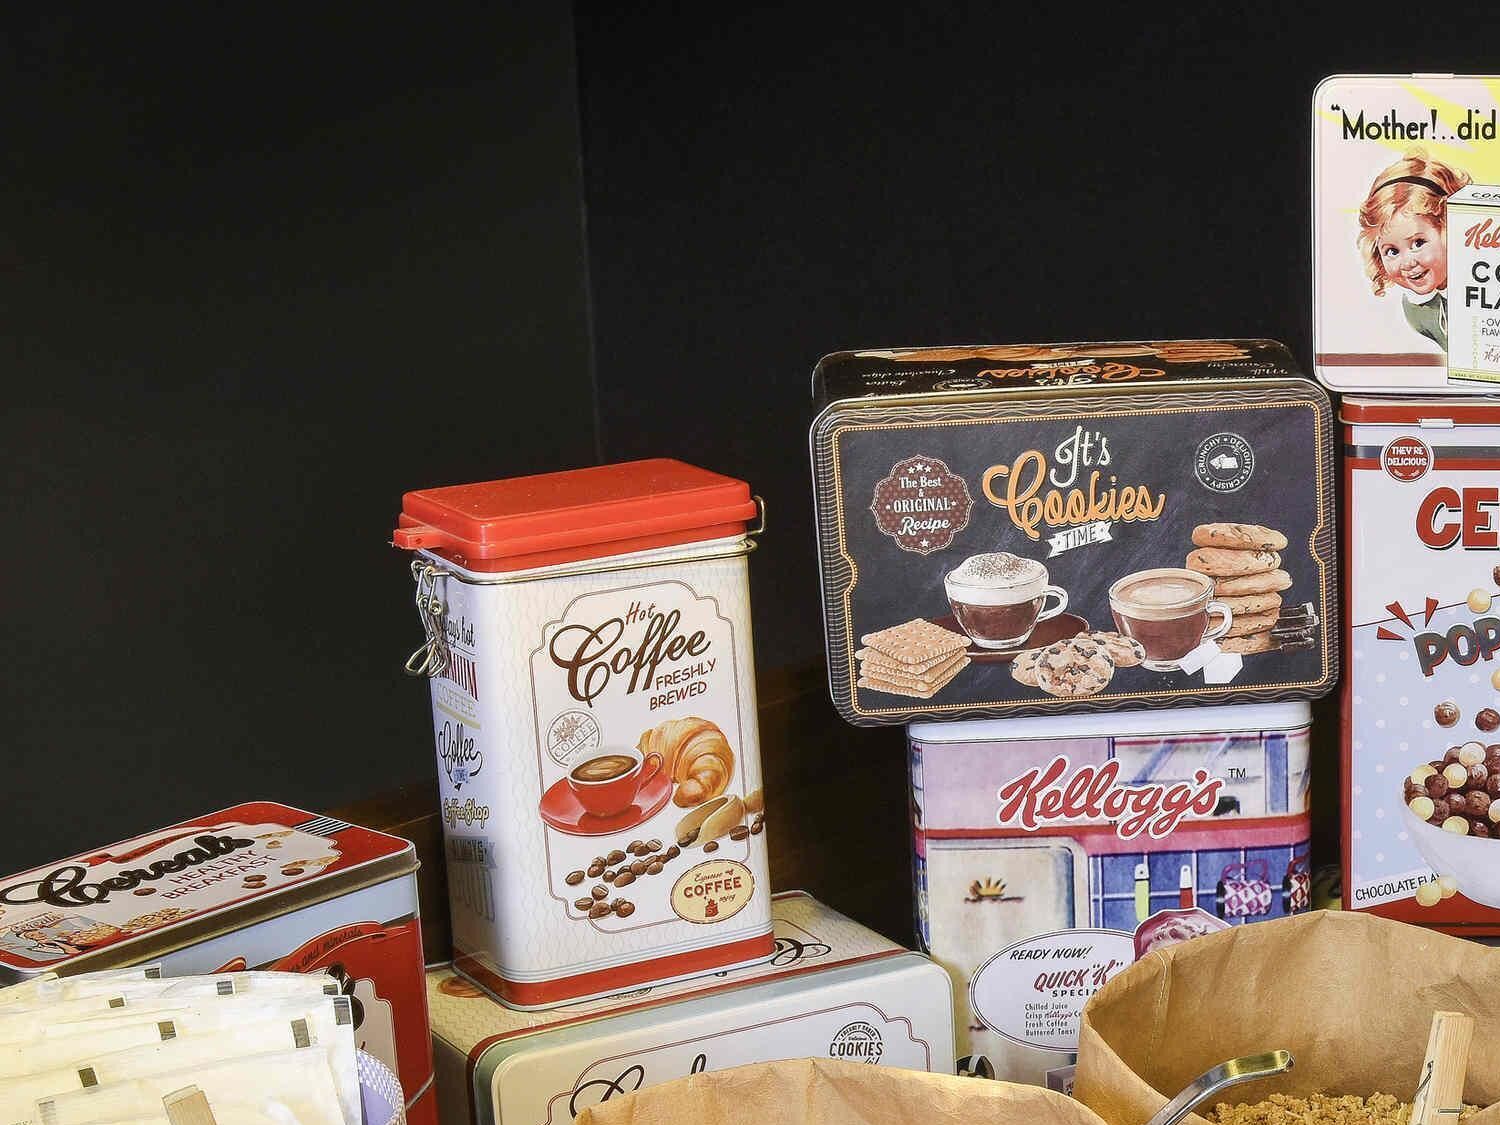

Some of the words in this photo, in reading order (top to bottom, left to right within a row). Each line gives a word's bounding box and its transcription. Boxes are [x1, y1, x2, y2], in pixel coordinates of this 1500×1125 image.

[1050, 424, 1111, 488] It's
[1199, 437, 1220, 474] CRUNCHY
[1230, 438, 1252, 475] DELIGHTS
[1387, 457, 1427, 466] DELICIOUS
[899, 476, 918, 489] The
[920, 476, 942, 488] Best
[918, 489, 924, 498] &
[981, 449, 1166, 539] Cookies
[1210, 479, 1241, 490] CRISPY
[893, 498, 951, 513] ORIGINAL
[898, 516, 951, 536] Recipe
[1062, 527, 1098, 549] TIME
[626, 601, 656, 625] Hot
[550, 609, 711, 708] Coffee
[655, 658, 716, 690] FRESHLY
[650, 681, 707, 711] BREWED
[438, 721, 483, 780] Coffee
[999, 756, 1223, 838] Kellogg's
[1228, 767, 1248, 779] TM
[1, 834, 255, 907] Cereals
[160, 855, 277, 899] BREAKFAST
[168, 850, 257, 884] HEALTHY
[683, 877, 742, 898] COFFEE
[1355, 877, 1416, 901] CHOCOLATE
[1010, 948, 1052, 960] READY
[1052, 946, 1093, 959] NOW!
[1034, 968, 1090, 992] QUICK
[1025, 1011, 1043, 1019] Crisp
[829, 1042, 884, 1056] COOKIES
